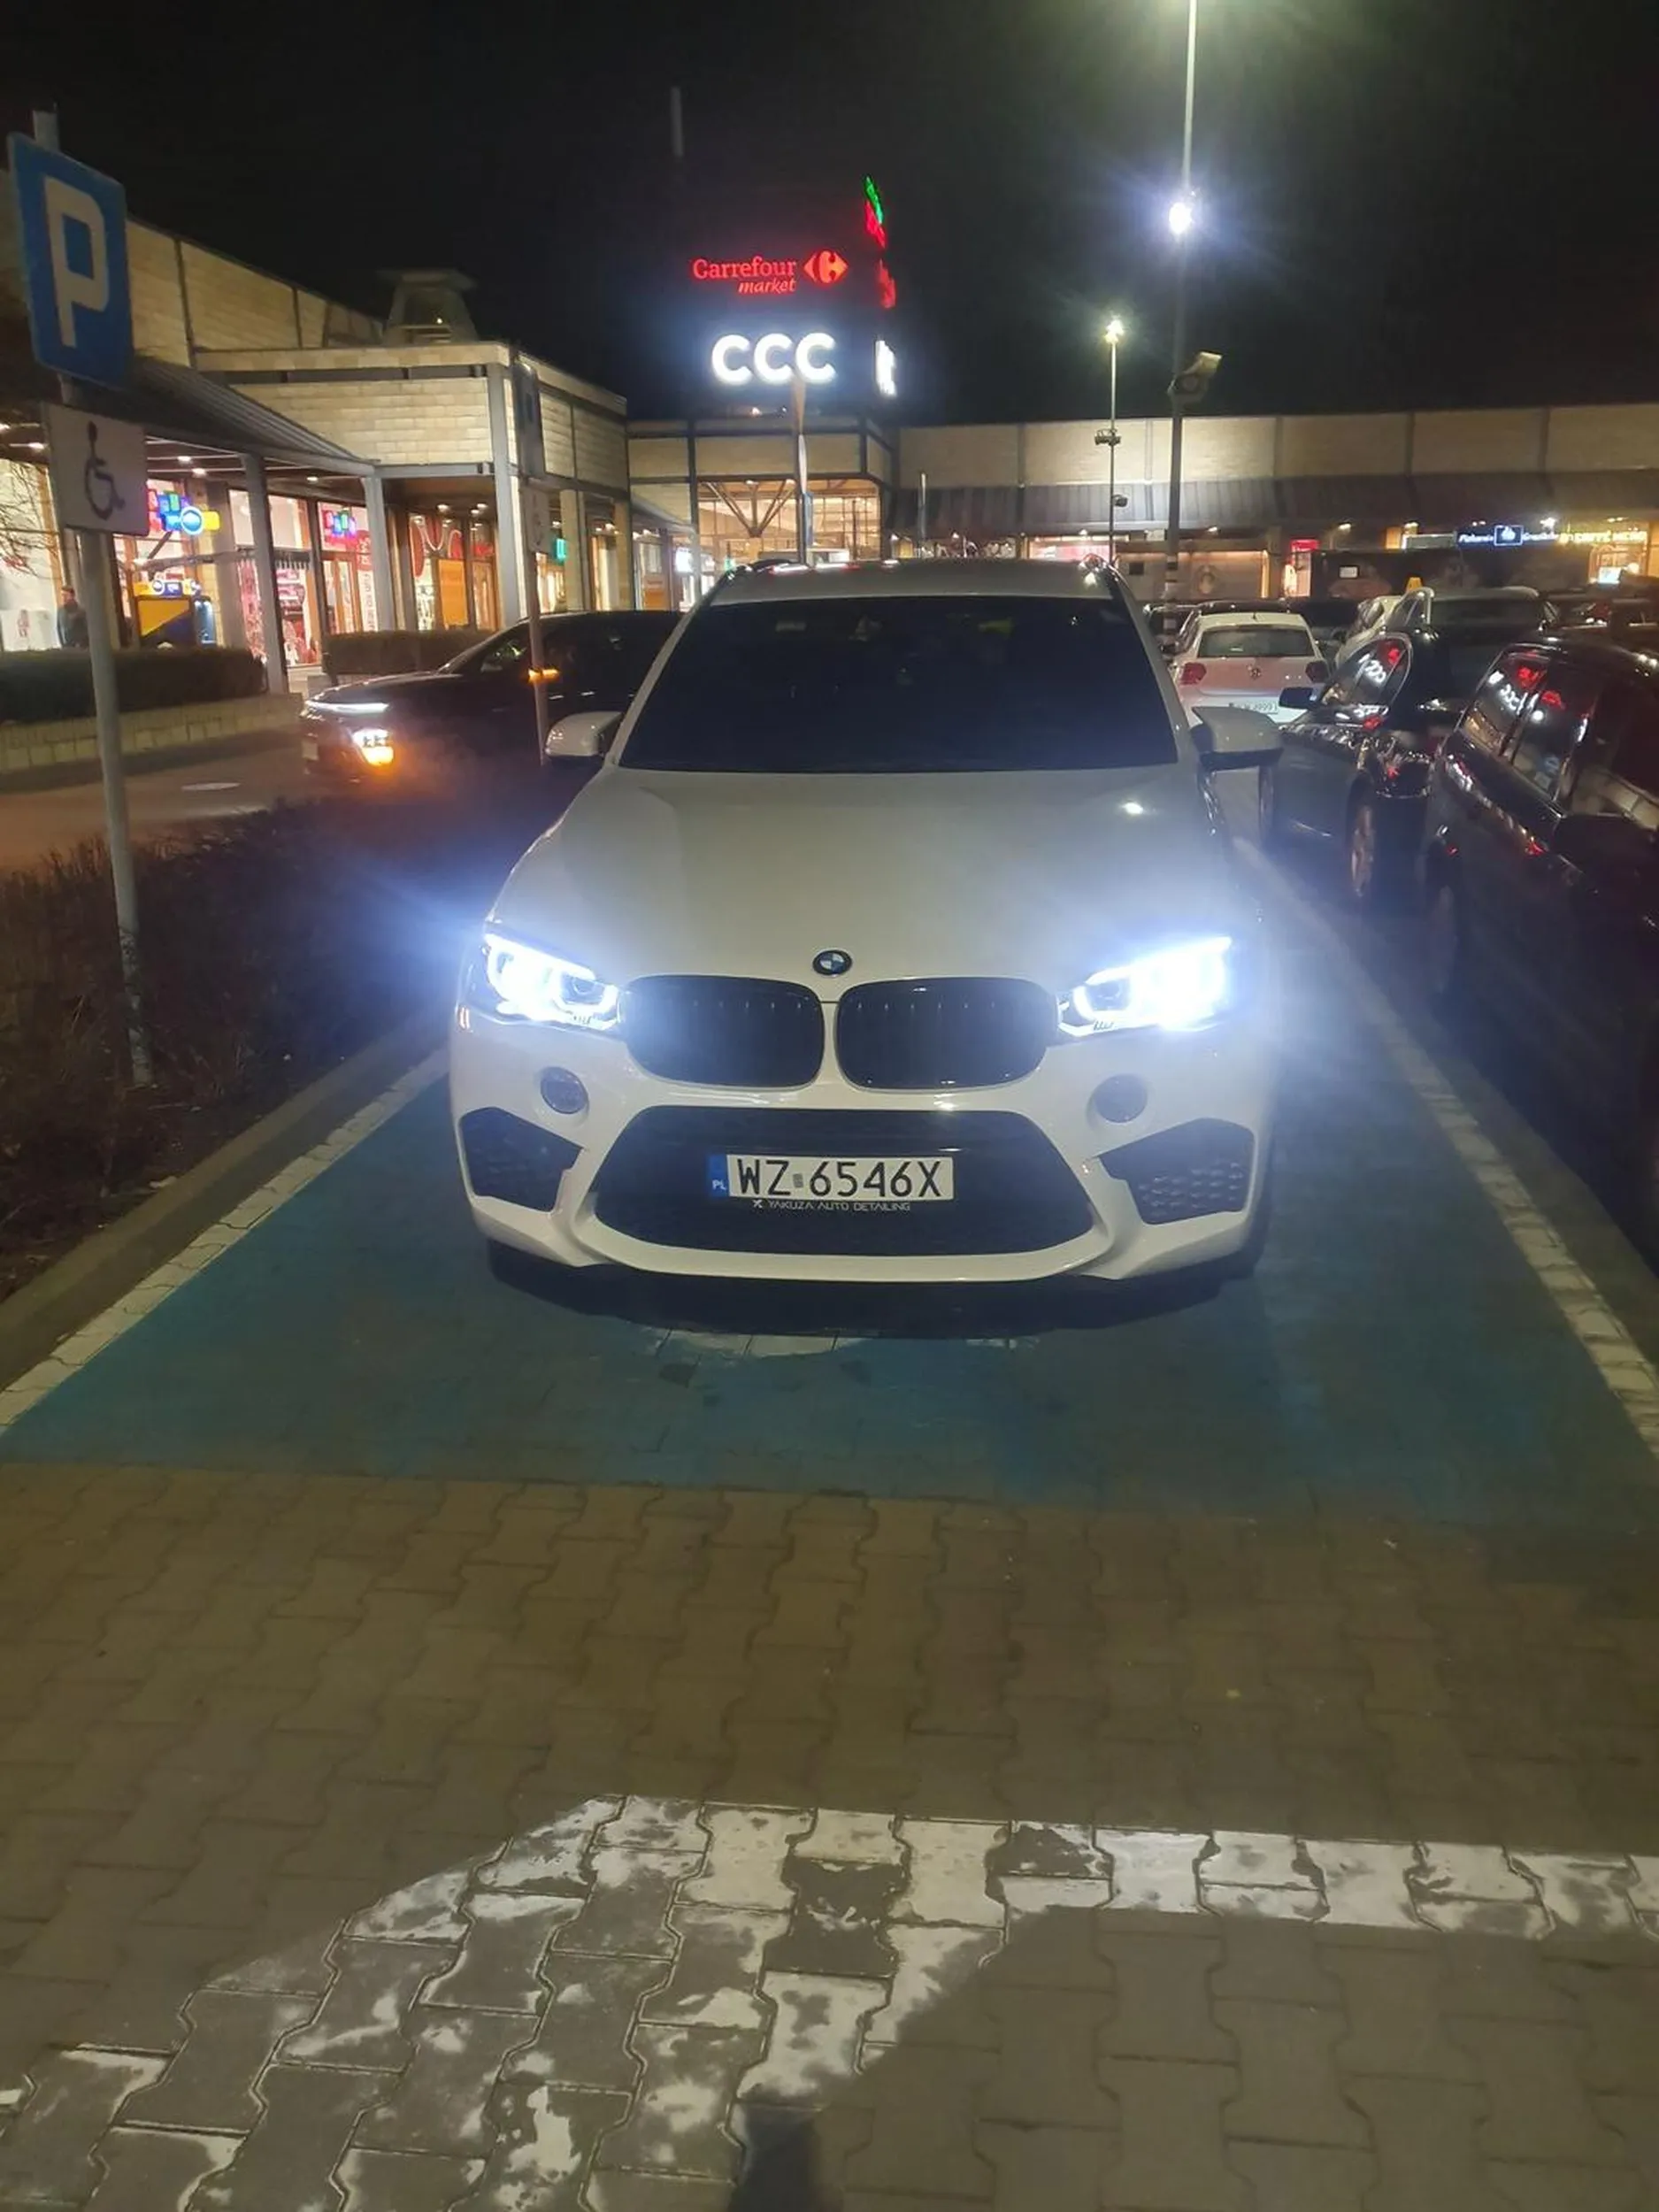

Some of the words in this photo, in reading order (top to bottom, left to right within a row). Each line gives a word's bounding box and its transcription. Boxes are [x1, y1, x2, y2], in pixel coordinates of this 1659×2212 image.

[44, 176, 107, 348] P
[693, 257, 796, 280] Carrefour
[738, 277, 796, 294] market
[711, 332, 836, 384] CCC
[712, 1179, 726, 1190] PL
[737, 1158, 791, 1196] WZ
[809, 1161, 941, 1198] 6546X
[768, 1199, 813, 1210] YAKUZA
[817, 1201, 849, 1211] AUTO
[853, 1202, 910, 1212] DETAILING
